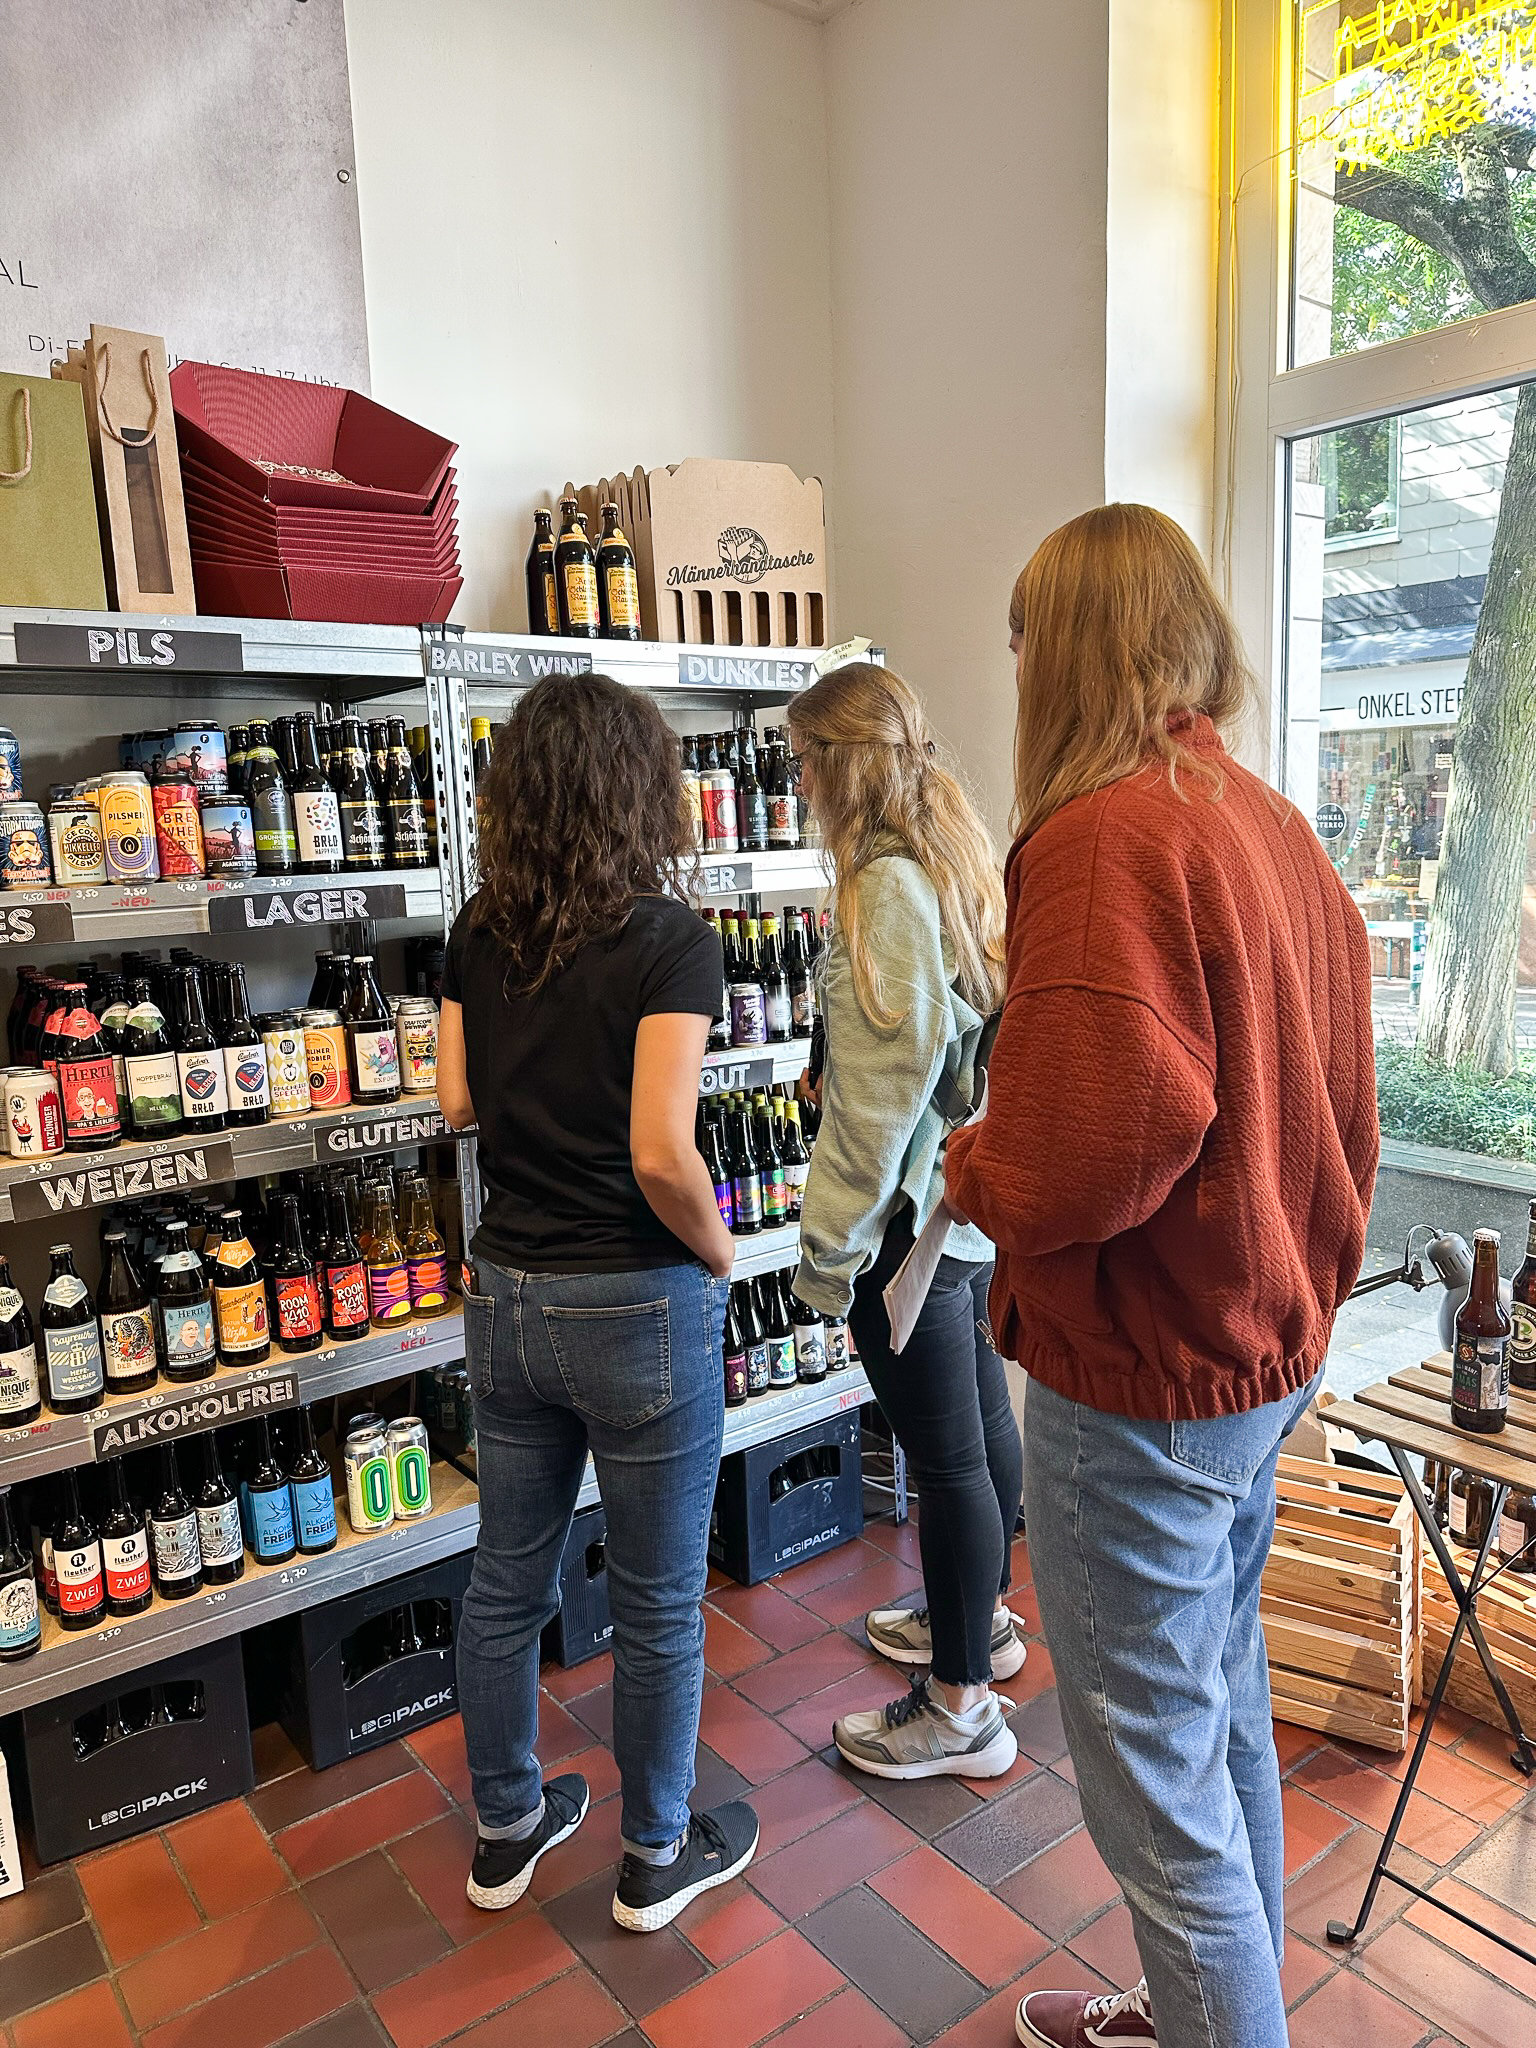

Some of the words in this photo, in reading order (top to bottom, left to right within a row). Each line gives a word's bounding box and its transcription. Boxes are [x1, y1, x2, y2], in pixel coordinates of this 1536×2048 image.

[666, 549, 815, 585] Männerhandtasche
[87, 629, 176, 666] PILS
[431, 647, 521, 676] BARLEY
[528, 655, 592, 677] WINE
[687, 656, 805, 688] DUNKLES
[1357, 691, 1416, 720] ONKEL
[108, 812, 145, 821] PILSNER
[163, 812, 193, 823] BRE
[65, 830, 78, 842] ICE
[164, 826, 195, 837] WHE
[63, 842, 101, 854] MIKKELLER
[167, 840, 196, 851] ART
[67, 853, 101, 868] PILSNER
[177, 883, 198, 893] 4,20
[224, 881, 245, 890] 4,60
[270, 878, 293, 887] 3,20
[22, 892, 44, 902] 4,50
[75, 888, 99, 900] 3,50
[123, 887, 148, 897] 3,50
[244, 889, 370, 928] LAGER
[0, 908, 36, 943] ES
[306, 1047, 331, 1055] RLINER
[64, 1063, 113, 1083] HERTL
[136, 1072, 172, 1083] HOPPEBRÄU
[373, 1075, 398, 1084] EXPORT
[410, 1068, 437, 1078] LAGER
[698, 1063, 751, 1094] OUT
[380, 1107, 397, 1118] 3,70
[43, 1104, 57, 1148] ANZÜNDER
[289, 1123, 307, 1133] 4,70
[227, 1133, 241, 1142] 3,-
[327, 1115, 479, 1152] GLUTENF
[148, 1144, 168, 1154] 3,20
[85, 1154, 104, 1165] 3,30
[29, 1162, 52, 1174] 3,50
[39, 1150, 208, 1211] WEIZEN
[336, 1279, 364, 1301] ROOM
[279, 1293, 309, 1312] ROOM
[341, 1291, 365, 1309] 1410
[177, 1308, 206, 1319] HERTL
[284, 1305, 310, 1322] 1410
[52, 1331, 96, 1347] Bayreuther
[406, 1326, 427, 1338] 4,20
[0, 1379, 31, 1397] NIQUE
[193, 1382, 216, 1394] 3,30
[140, 1395, 164, 1409] 3,80
[82, 1409, 110, 1423] 2,90
[102, 1379, 295, 1453] ALKOHOLFREI
[3, 1430, 29, 1443] 3,30
[305, 1513, 335, 1527] ALKOHO
[262, 1521, 293, 1537] ALKOHO
[775, 1524, 841, 1563] LOGIPACK
[114, 1551, 145, 1563] fleuther
[63, 1563, 96, 1577] fleuther
[280, 1567, 308, 1584] 2,70
[116, 1570, 148, 1590] ZWEI
[66, 1583, 99, 1603] ZWEI
[4, 1611, 35, 1628] MUCKI
[97, 1627, 122, 1642] 2,50
[349, 1688, 453, 1741] LOGIPACK
[88, 1777, 209, 1832] LOGIPACK
